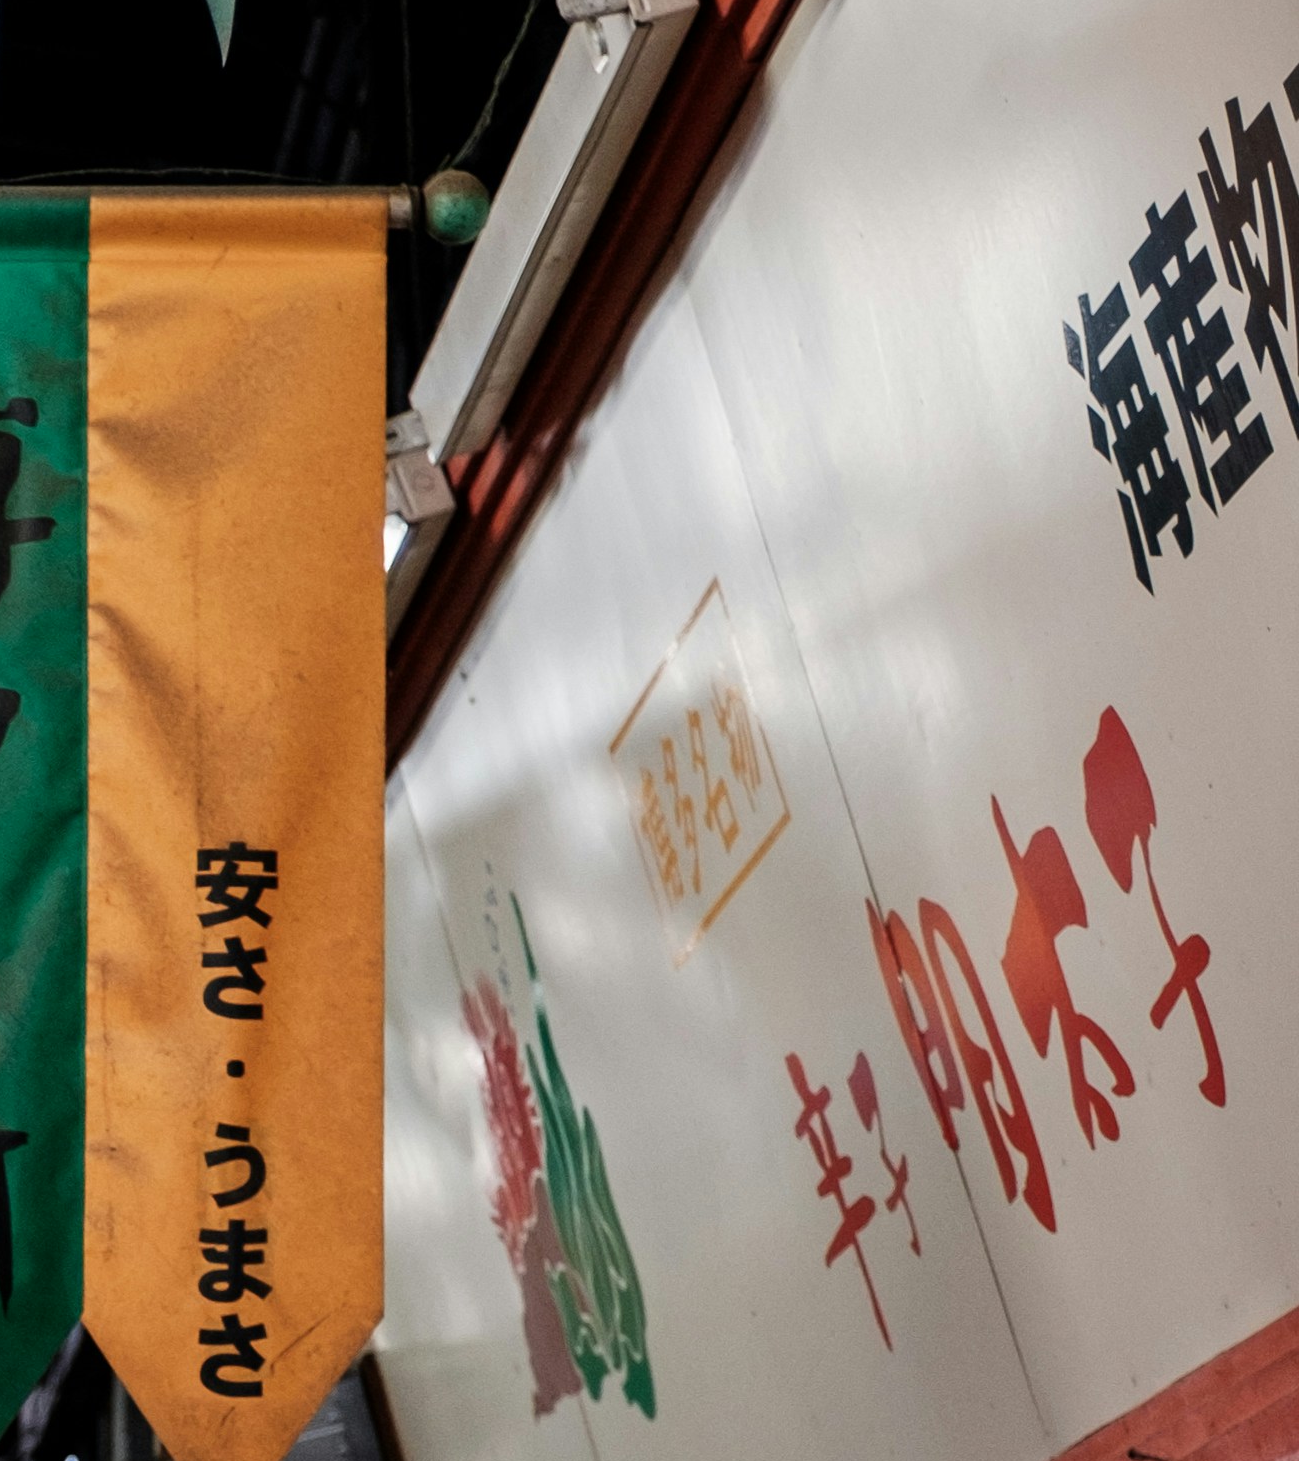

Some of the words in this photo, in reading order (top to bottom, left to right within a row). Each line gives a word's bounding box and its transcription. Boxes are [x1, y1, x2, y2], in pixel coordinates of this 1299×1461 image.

[1063, 62, 1299, 597] 海産物
[631, 677, 762, 913] 博多名物
[786, 705, 1226, 1353] 辛子明太子
[194, 840, 281, 1399] 安さ・うまさ
